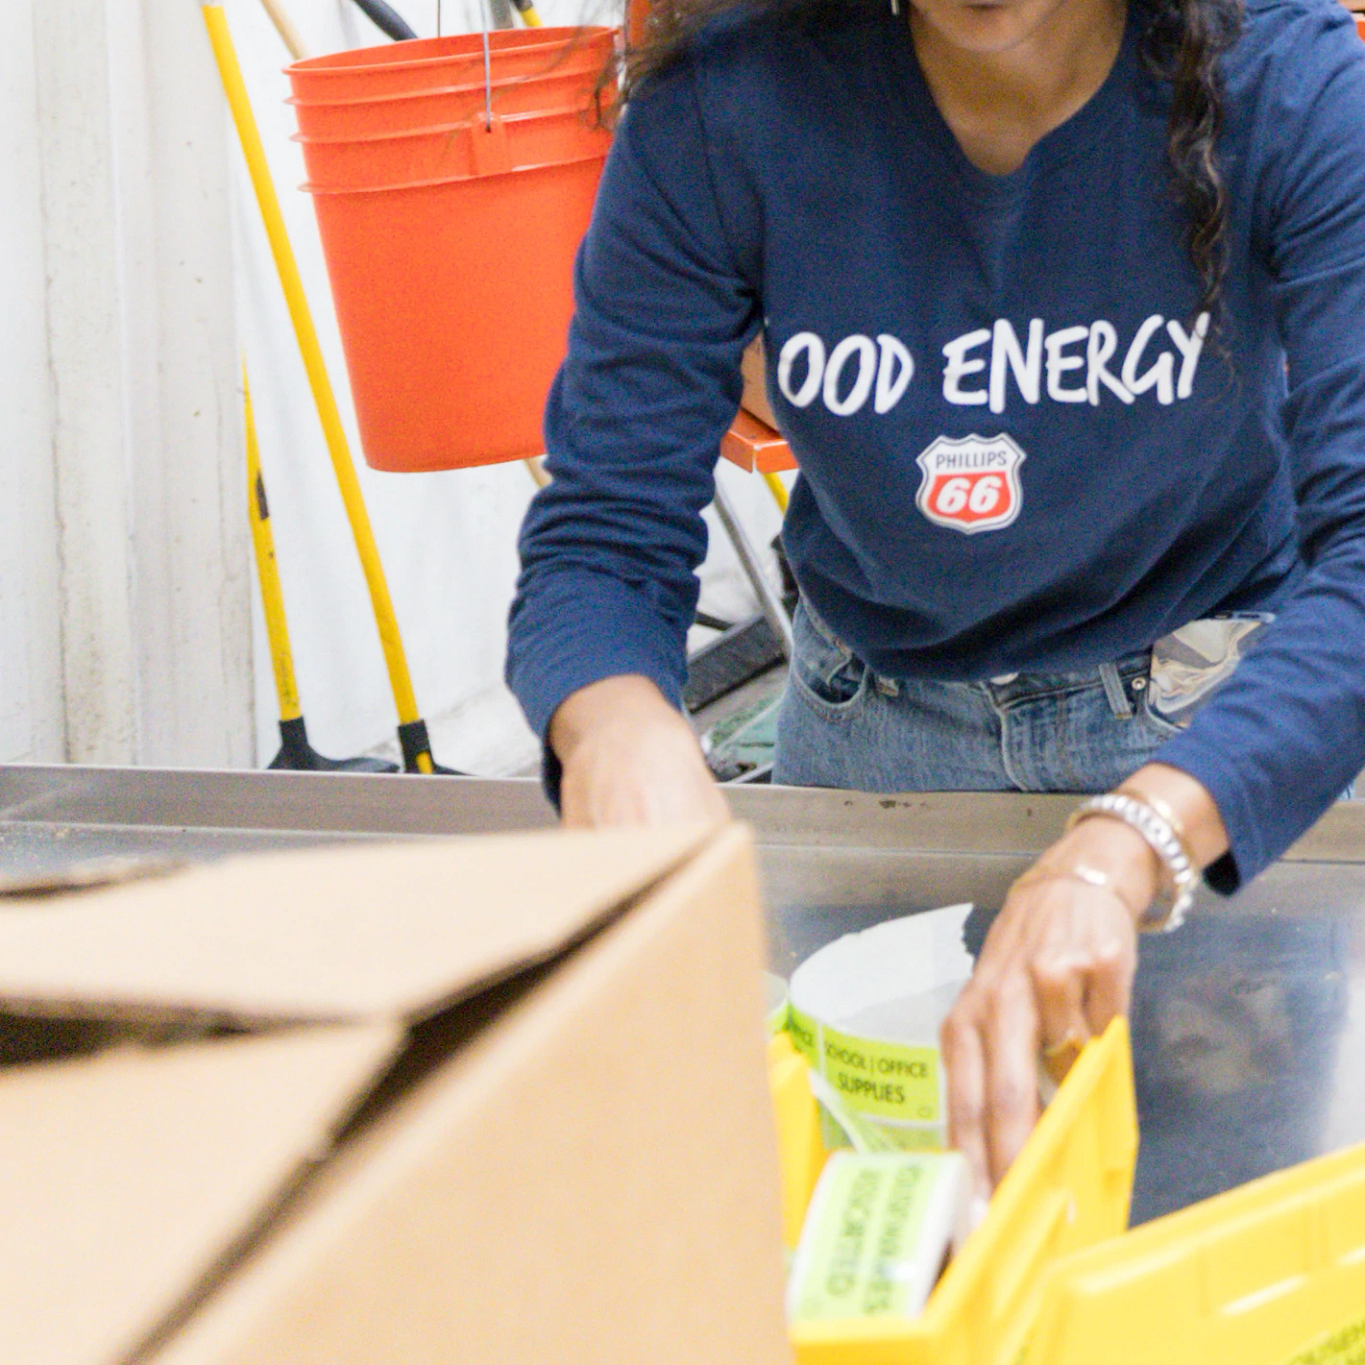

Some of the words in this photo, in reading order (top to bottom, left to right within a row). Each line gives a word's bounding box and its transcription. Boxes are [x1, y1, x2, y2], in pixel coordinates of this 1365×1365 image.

[777, 331, 915, 417] OOD
[942, 311, 1211, 414] ENERGY
[935, 450, 1008, 469] PHILLIPS
[935, 476, 1003, 515] 66
[877, 1058, 928, 1079] OFFICE
[838, 1071, 906, 1104] SUPPLIES
